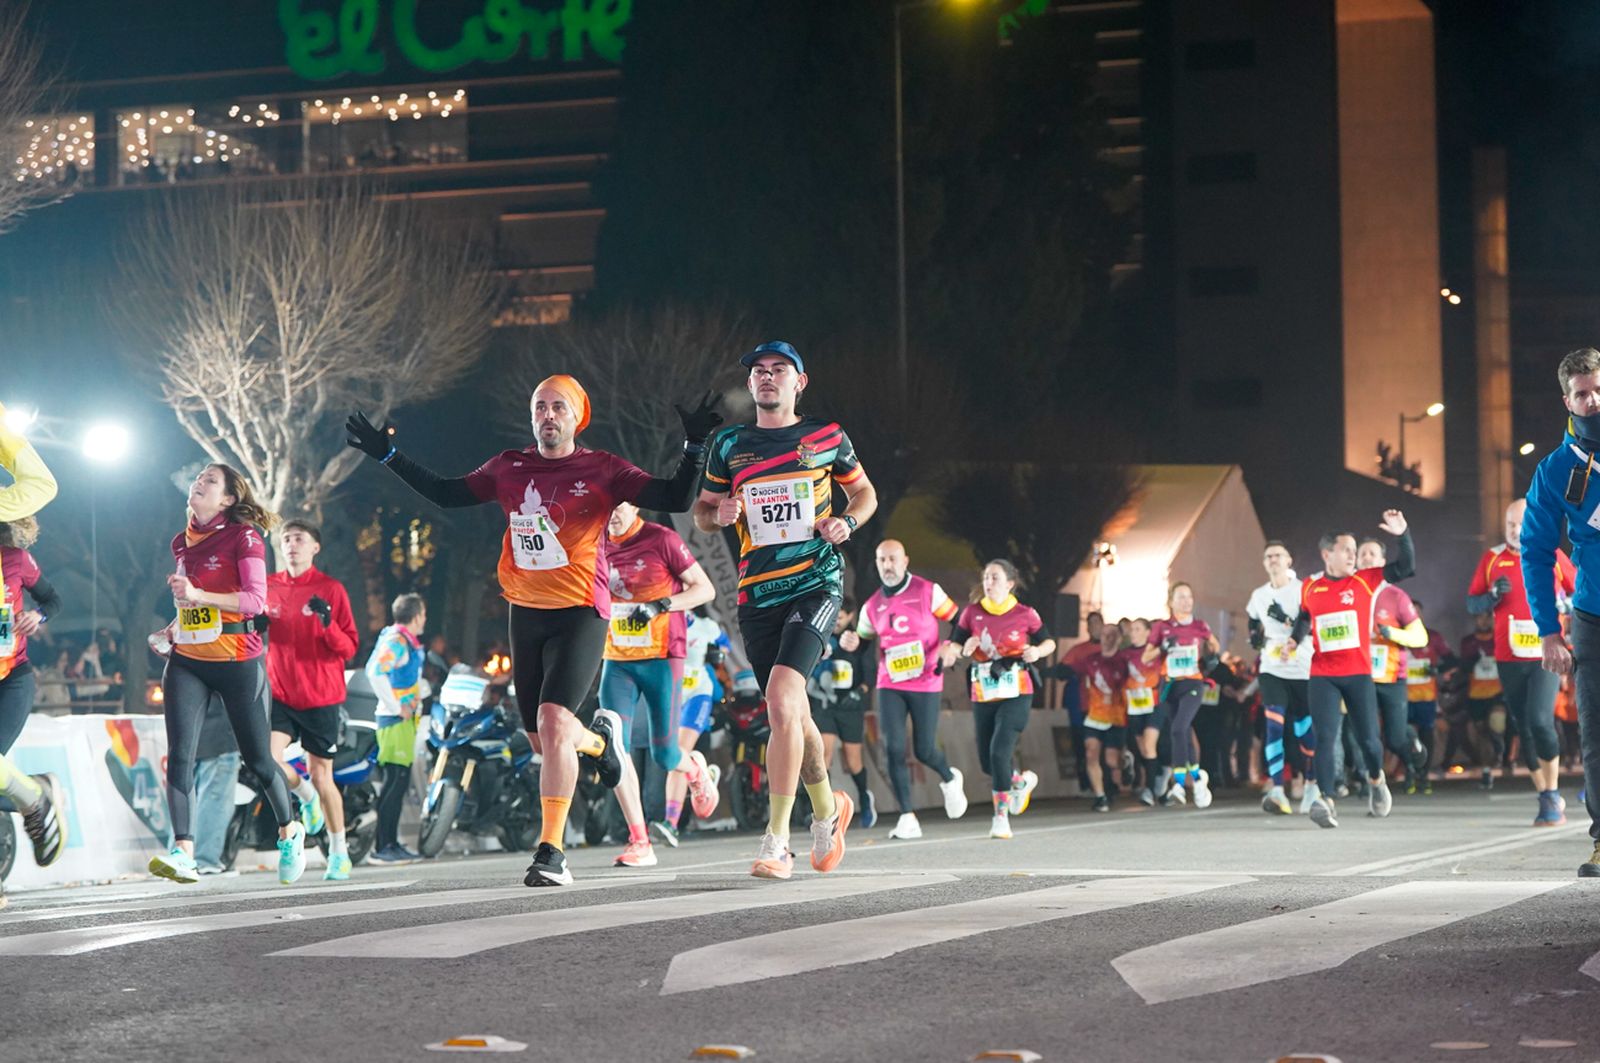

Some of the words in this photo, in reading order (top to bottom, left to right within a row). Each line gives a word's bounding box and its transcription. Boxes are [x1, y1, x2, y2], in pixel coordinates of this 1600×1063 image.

[759, 488, 779, 496] NOCHE
[780, 486, 788, 494] DE
[752, 497, 765, 505] SAN
[761, 502, 801, 524] 5271
[517, 534, 545, 551] 750
[1326, 625, 1350, 638] 7831
[892, 655, 919, 670] 13017
